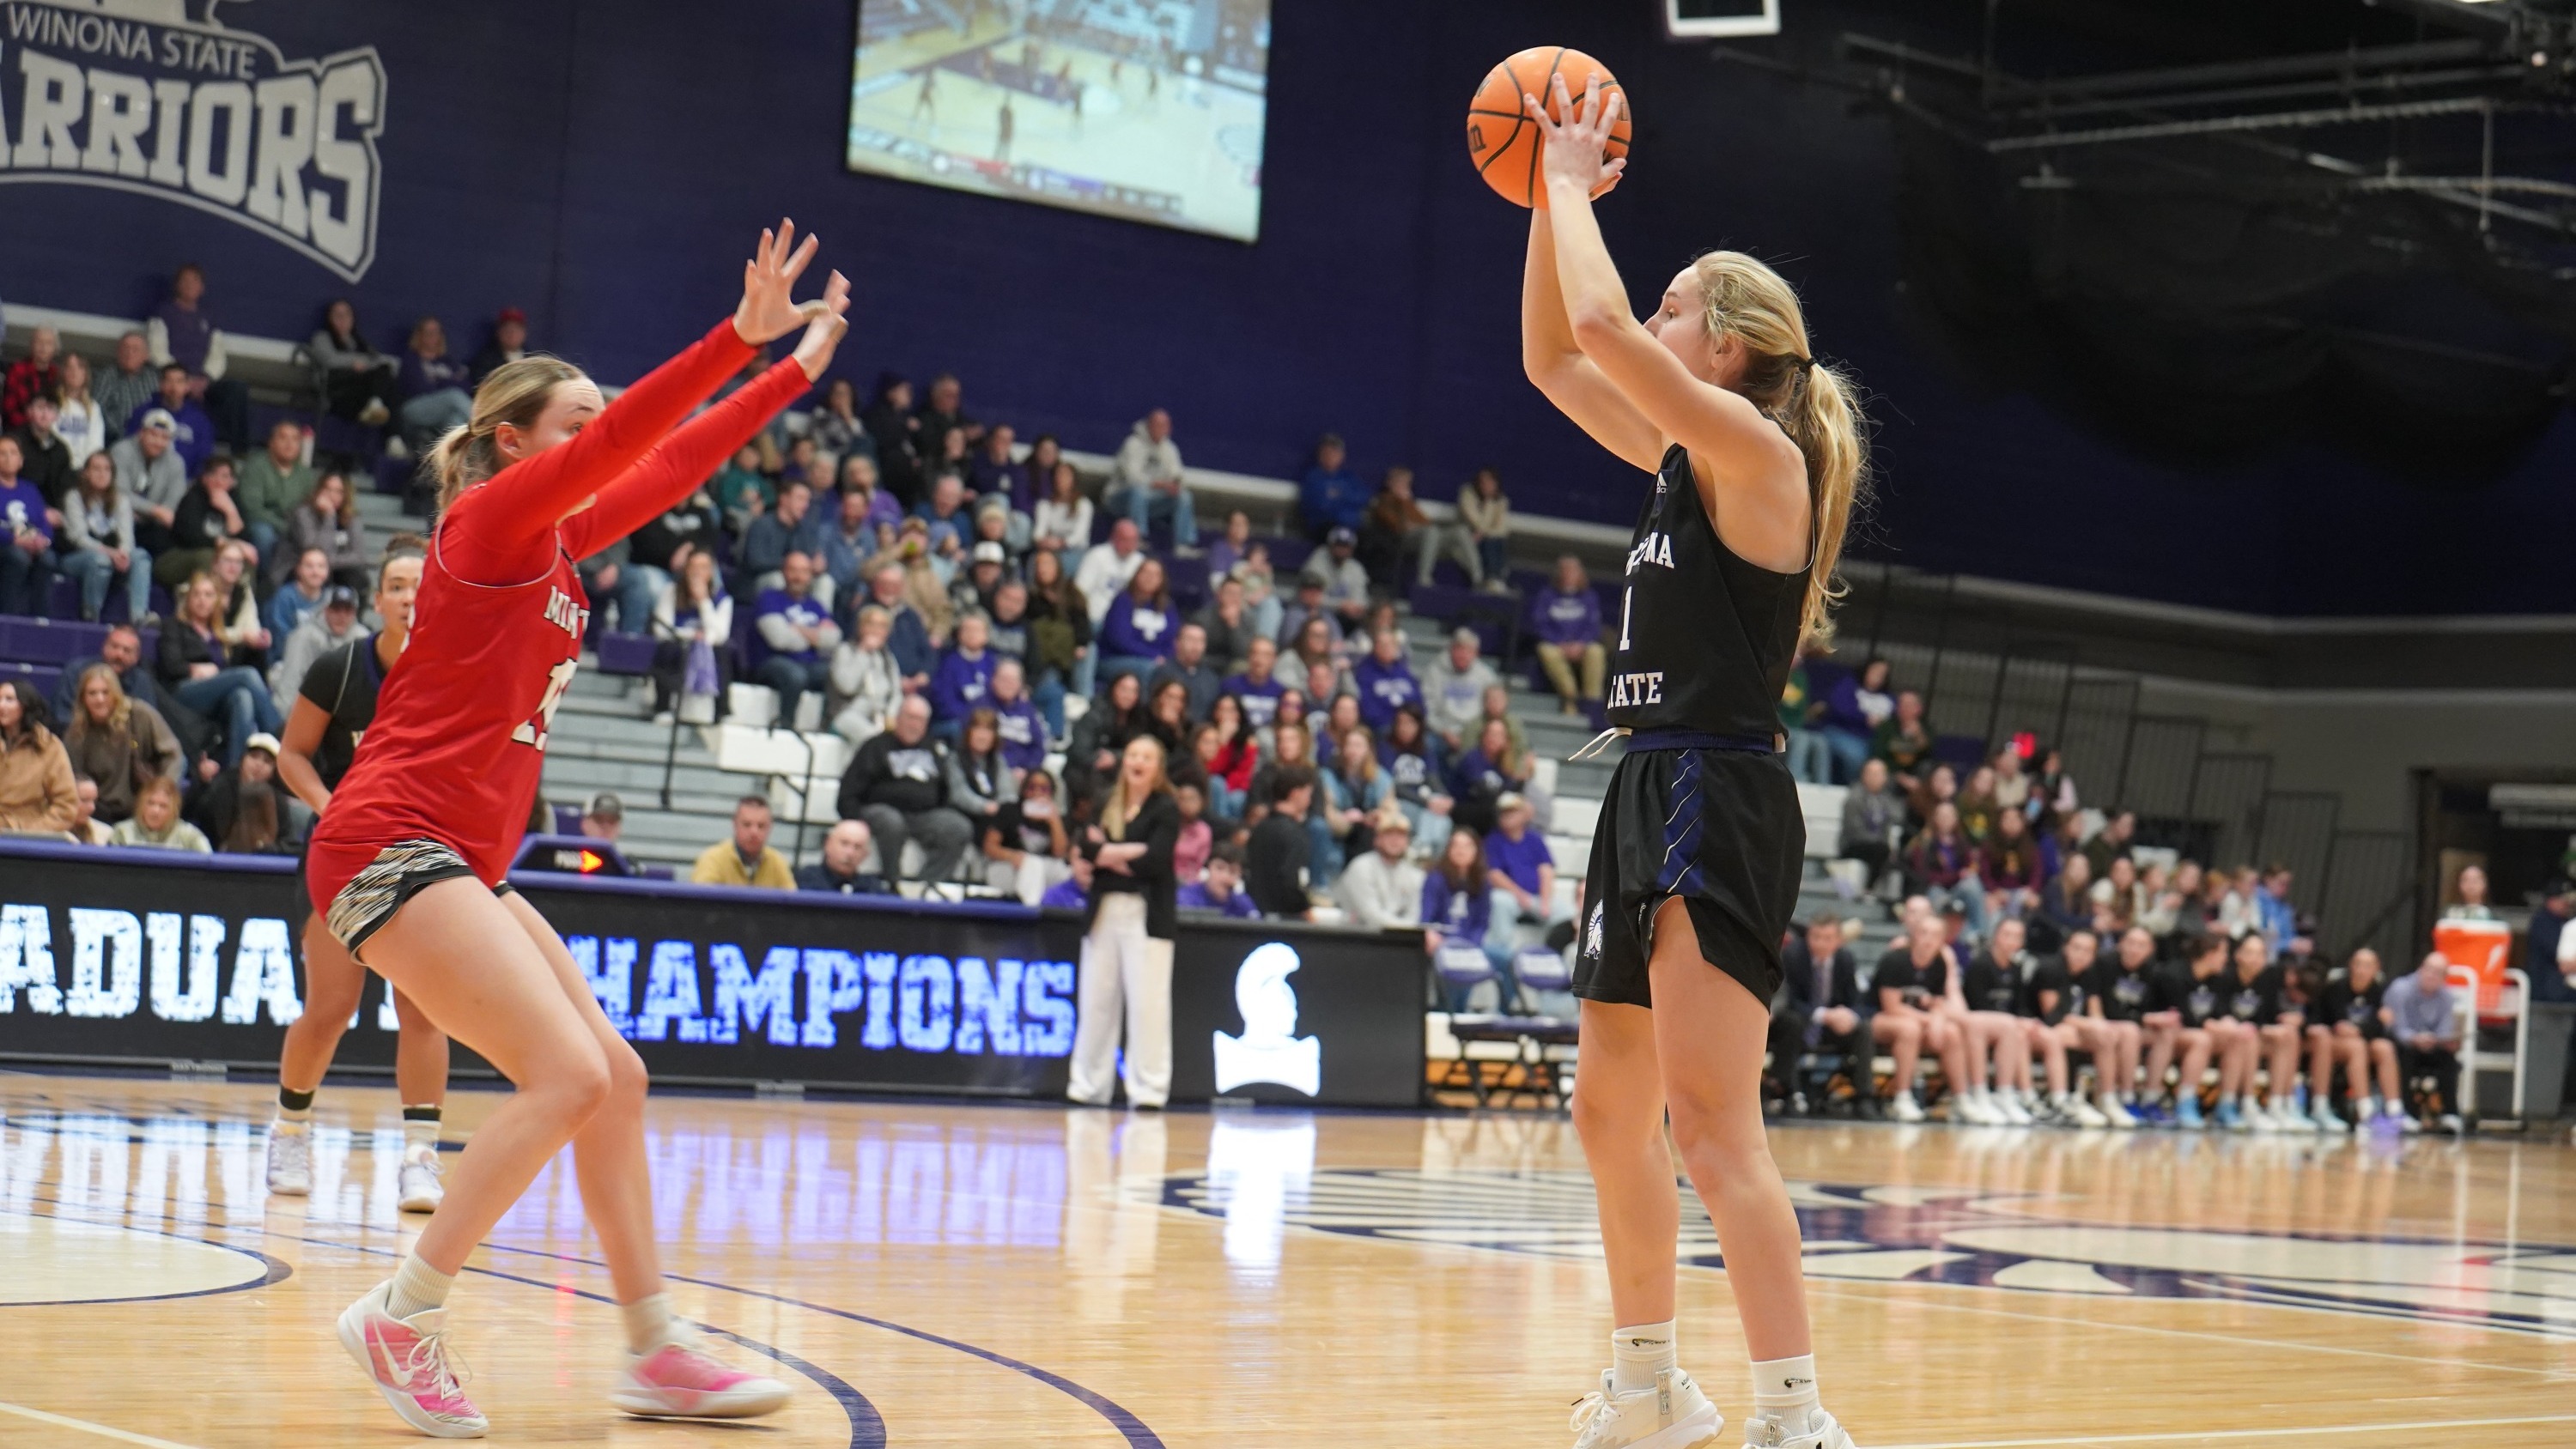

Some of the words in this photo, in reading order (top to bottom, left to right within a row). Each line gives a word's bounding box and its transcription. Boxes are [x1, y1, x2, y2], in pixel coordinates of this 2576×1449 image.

[7, 3, 153, 63] WINONA
[161, 31, 257, 81] STATE
[0, 45, 375, 267] RRIORS
[559, 933, 1075, 1058] HAMPIONS
